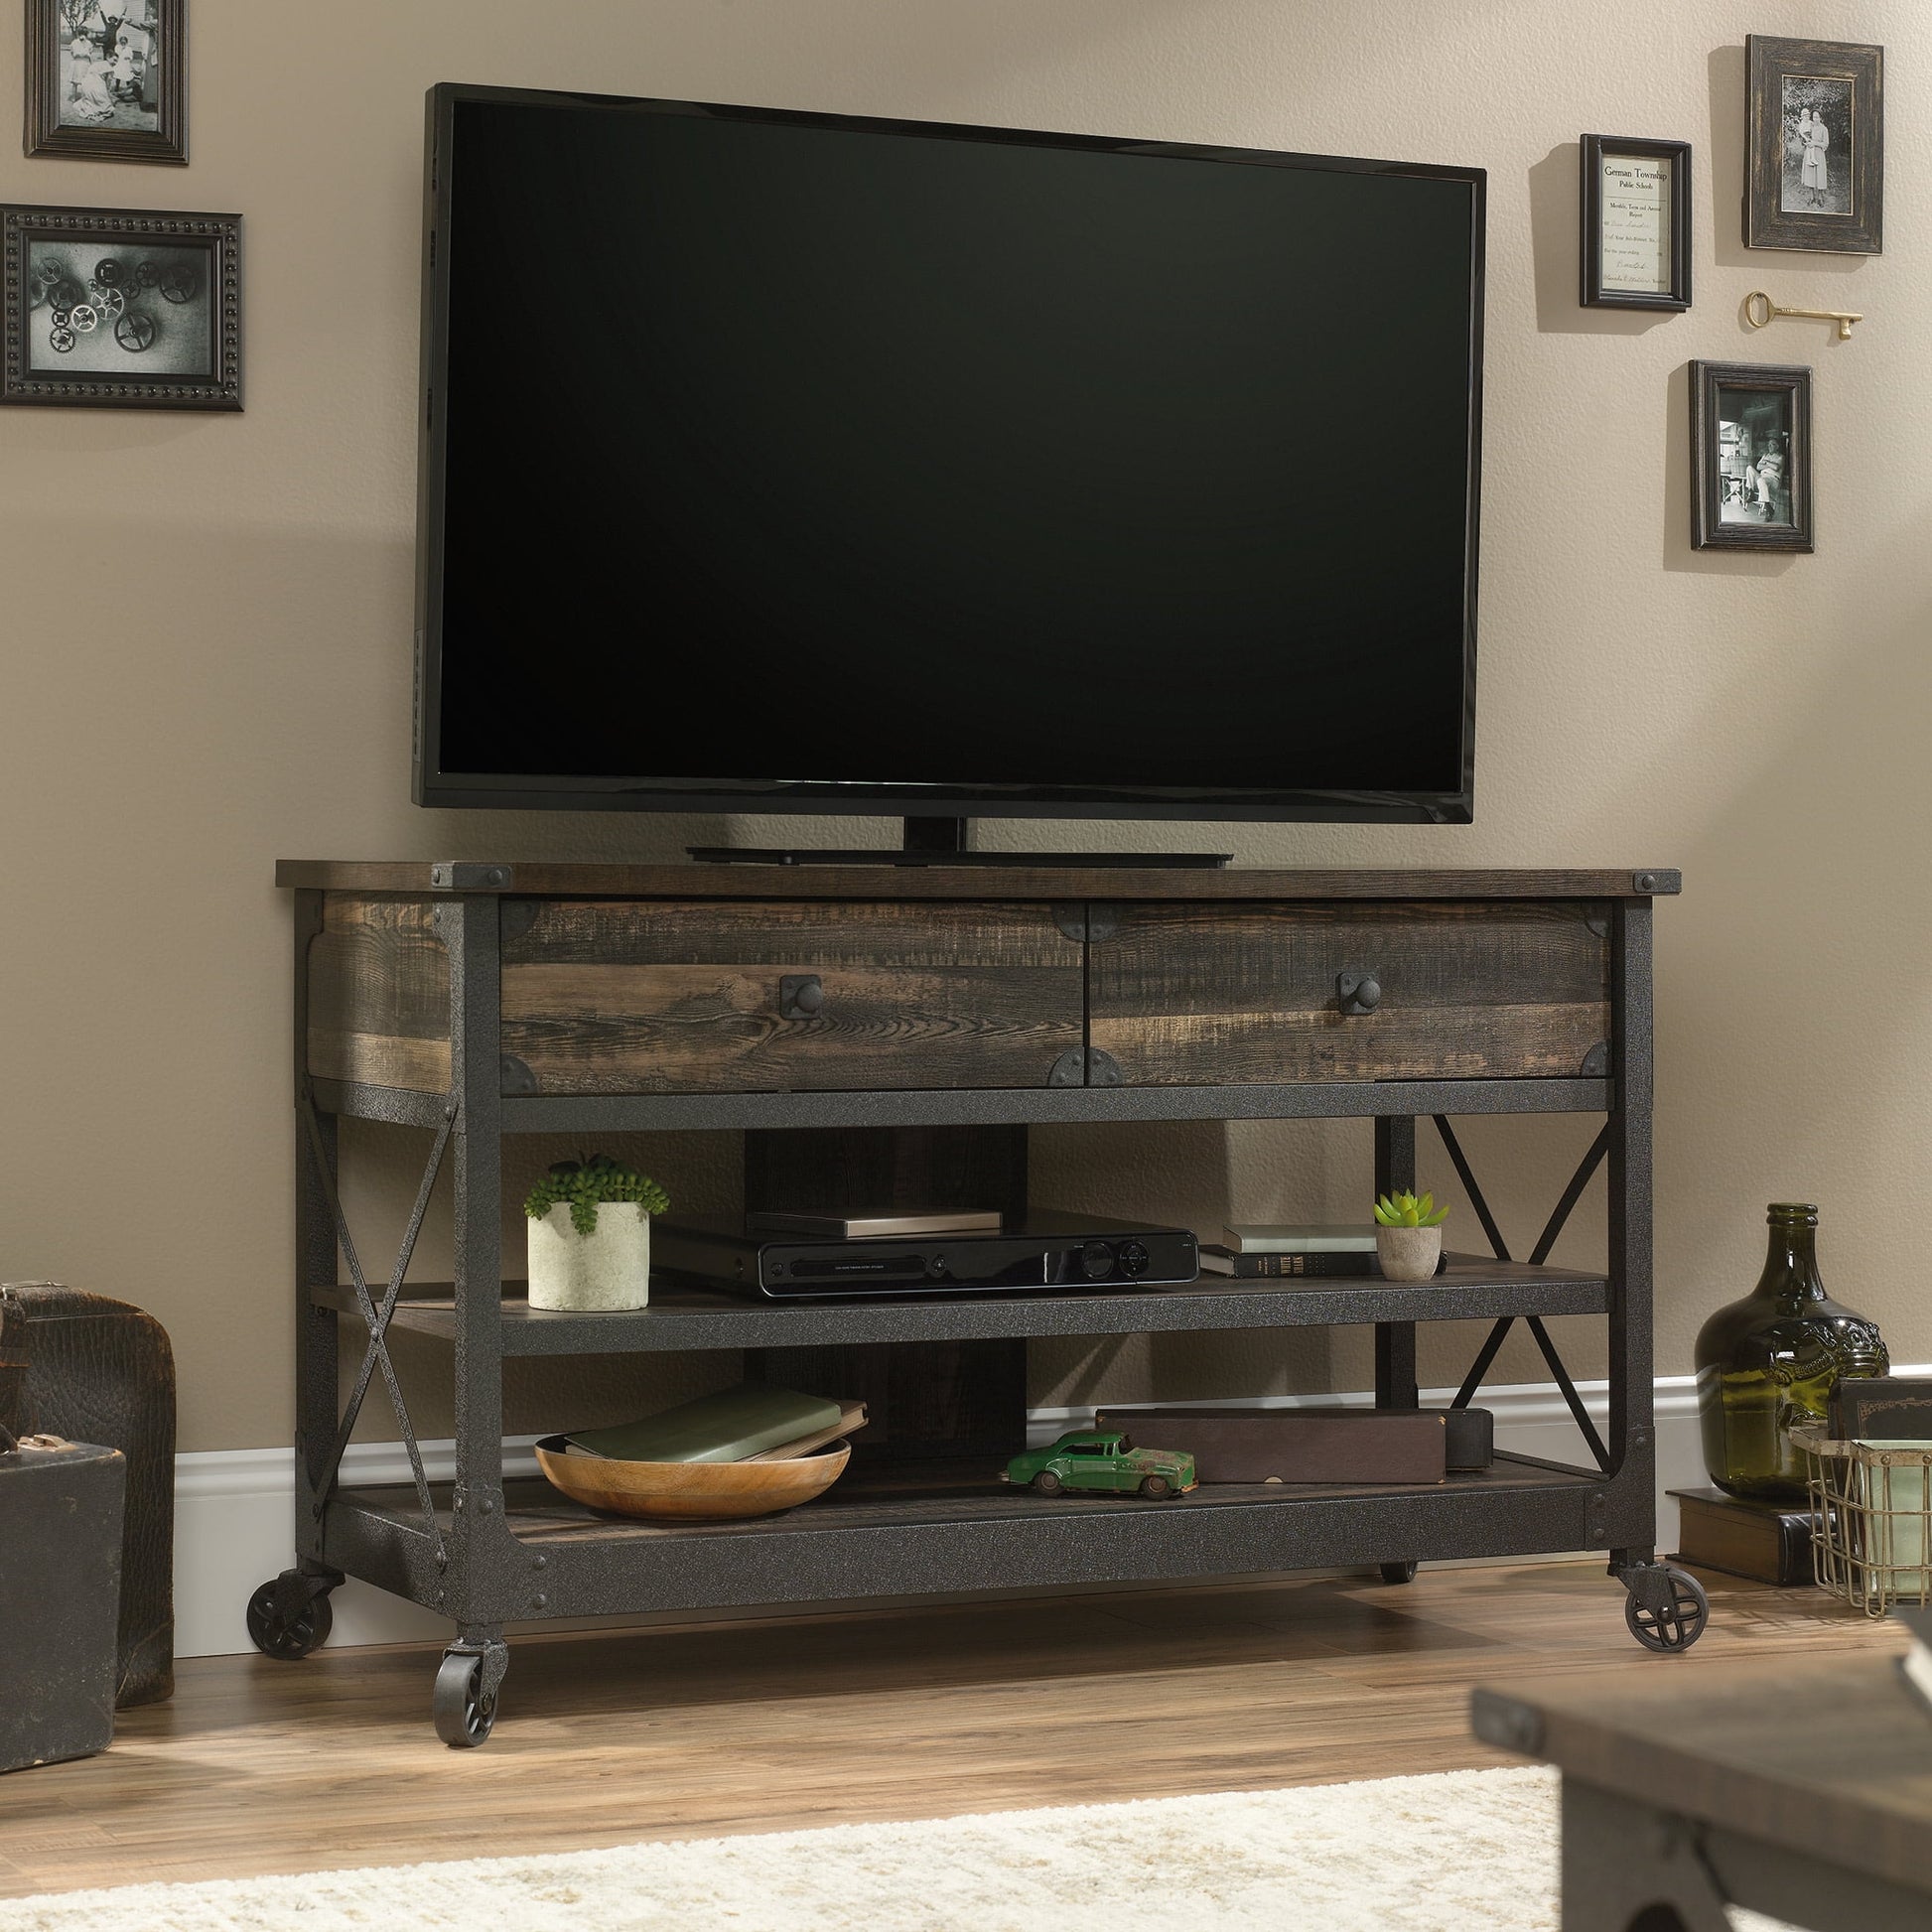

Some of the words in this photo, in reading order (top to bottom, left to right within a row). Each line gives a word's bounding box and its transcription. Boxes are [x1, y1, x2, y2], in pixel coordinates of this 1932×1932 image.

[1604, 165, 1632, 178] German
[1634, 168, 1667, 182] Township
[1619, 180, 1635, 189] Public
